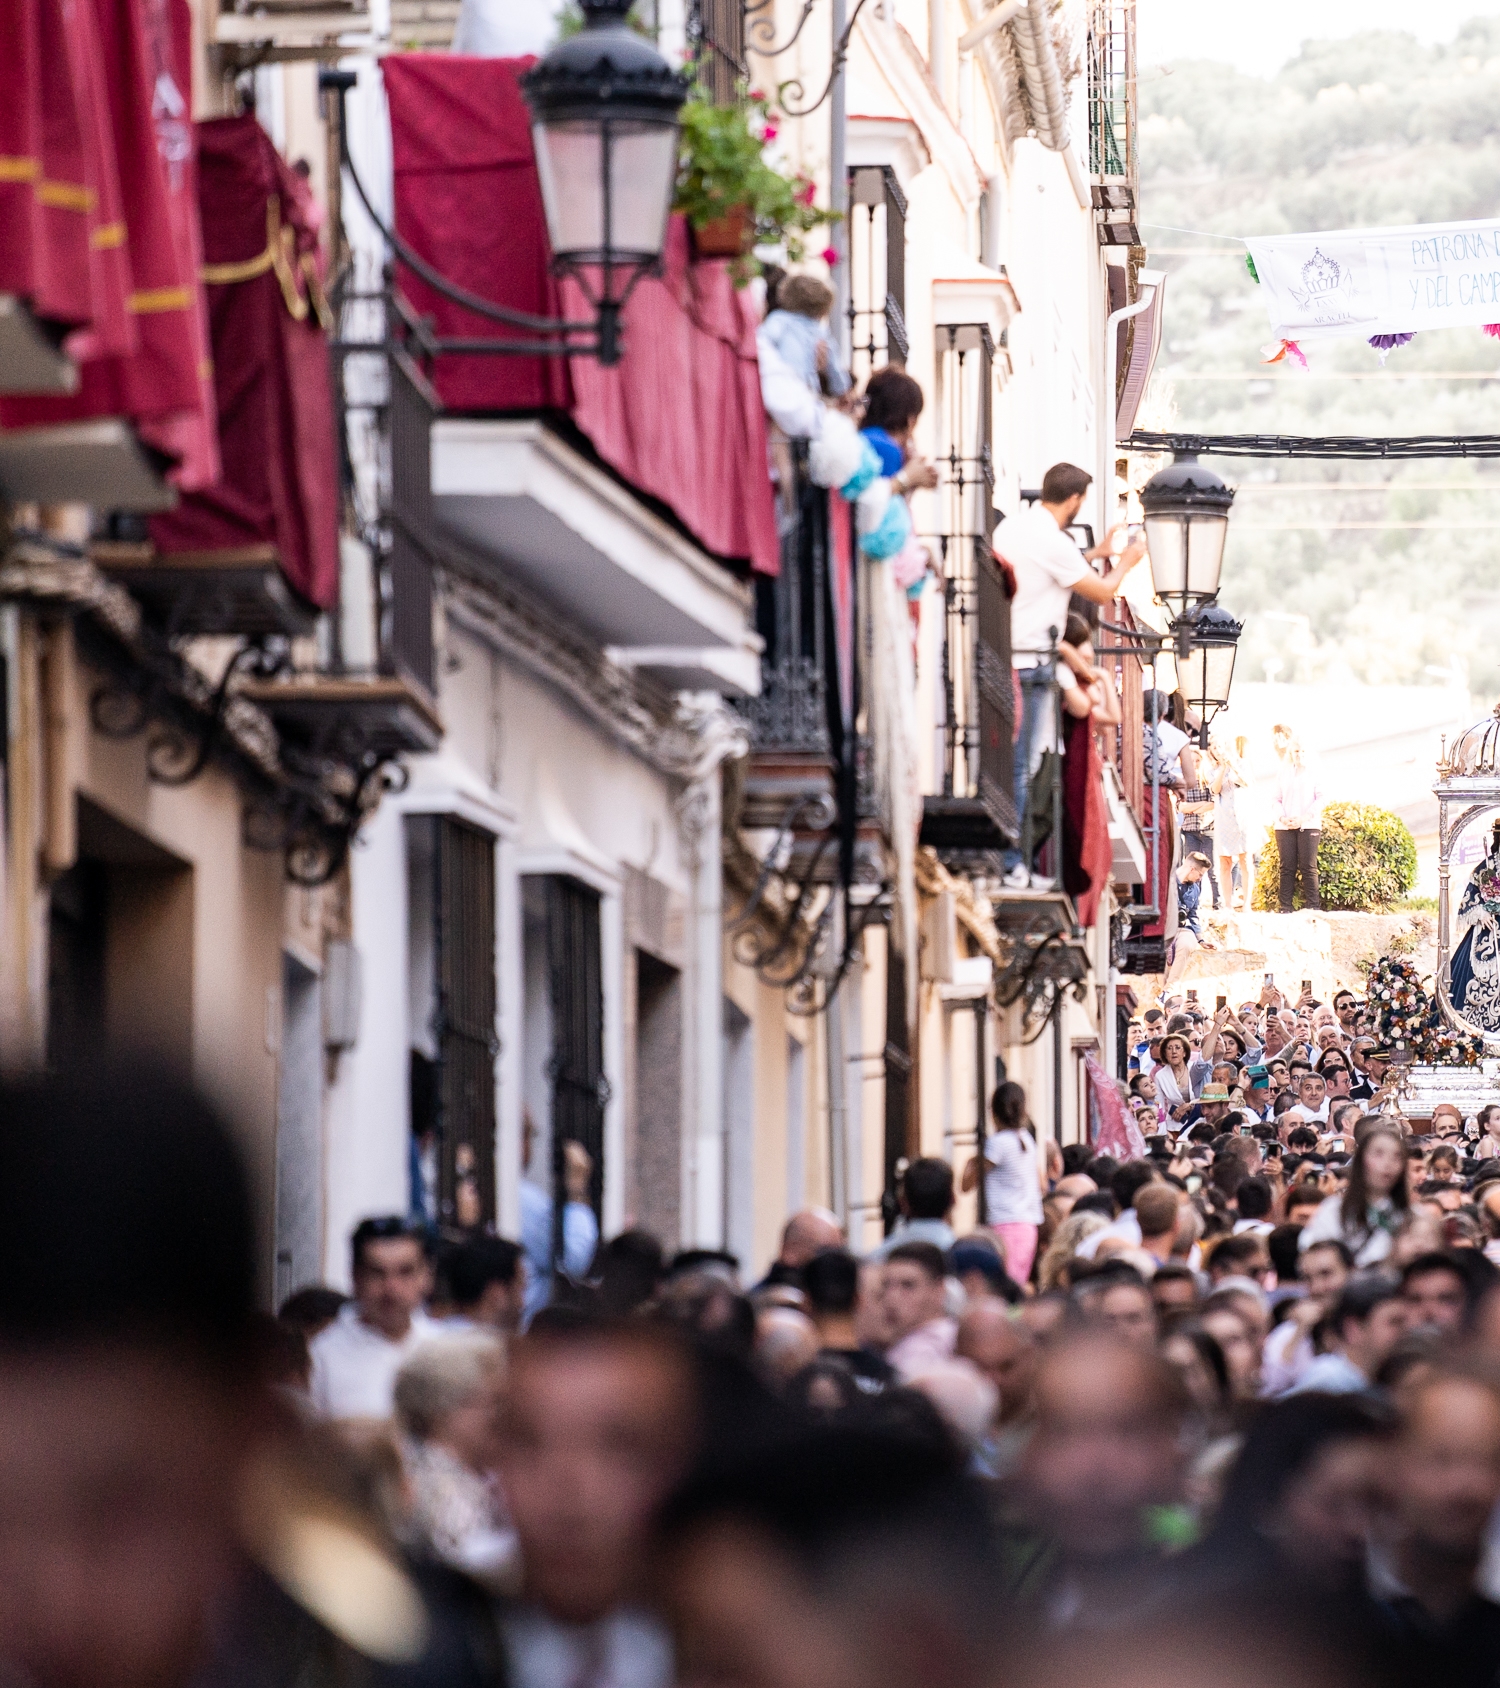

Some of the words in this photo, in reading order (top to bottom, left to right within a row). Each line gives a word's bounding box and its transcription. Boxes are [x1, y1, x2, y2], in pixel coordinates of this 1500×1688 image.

[1411, 233, 1488, 265] PATRONA
[1408, 278, 1419, 310] Y
[1426, 275, 1453, 309] DEL
